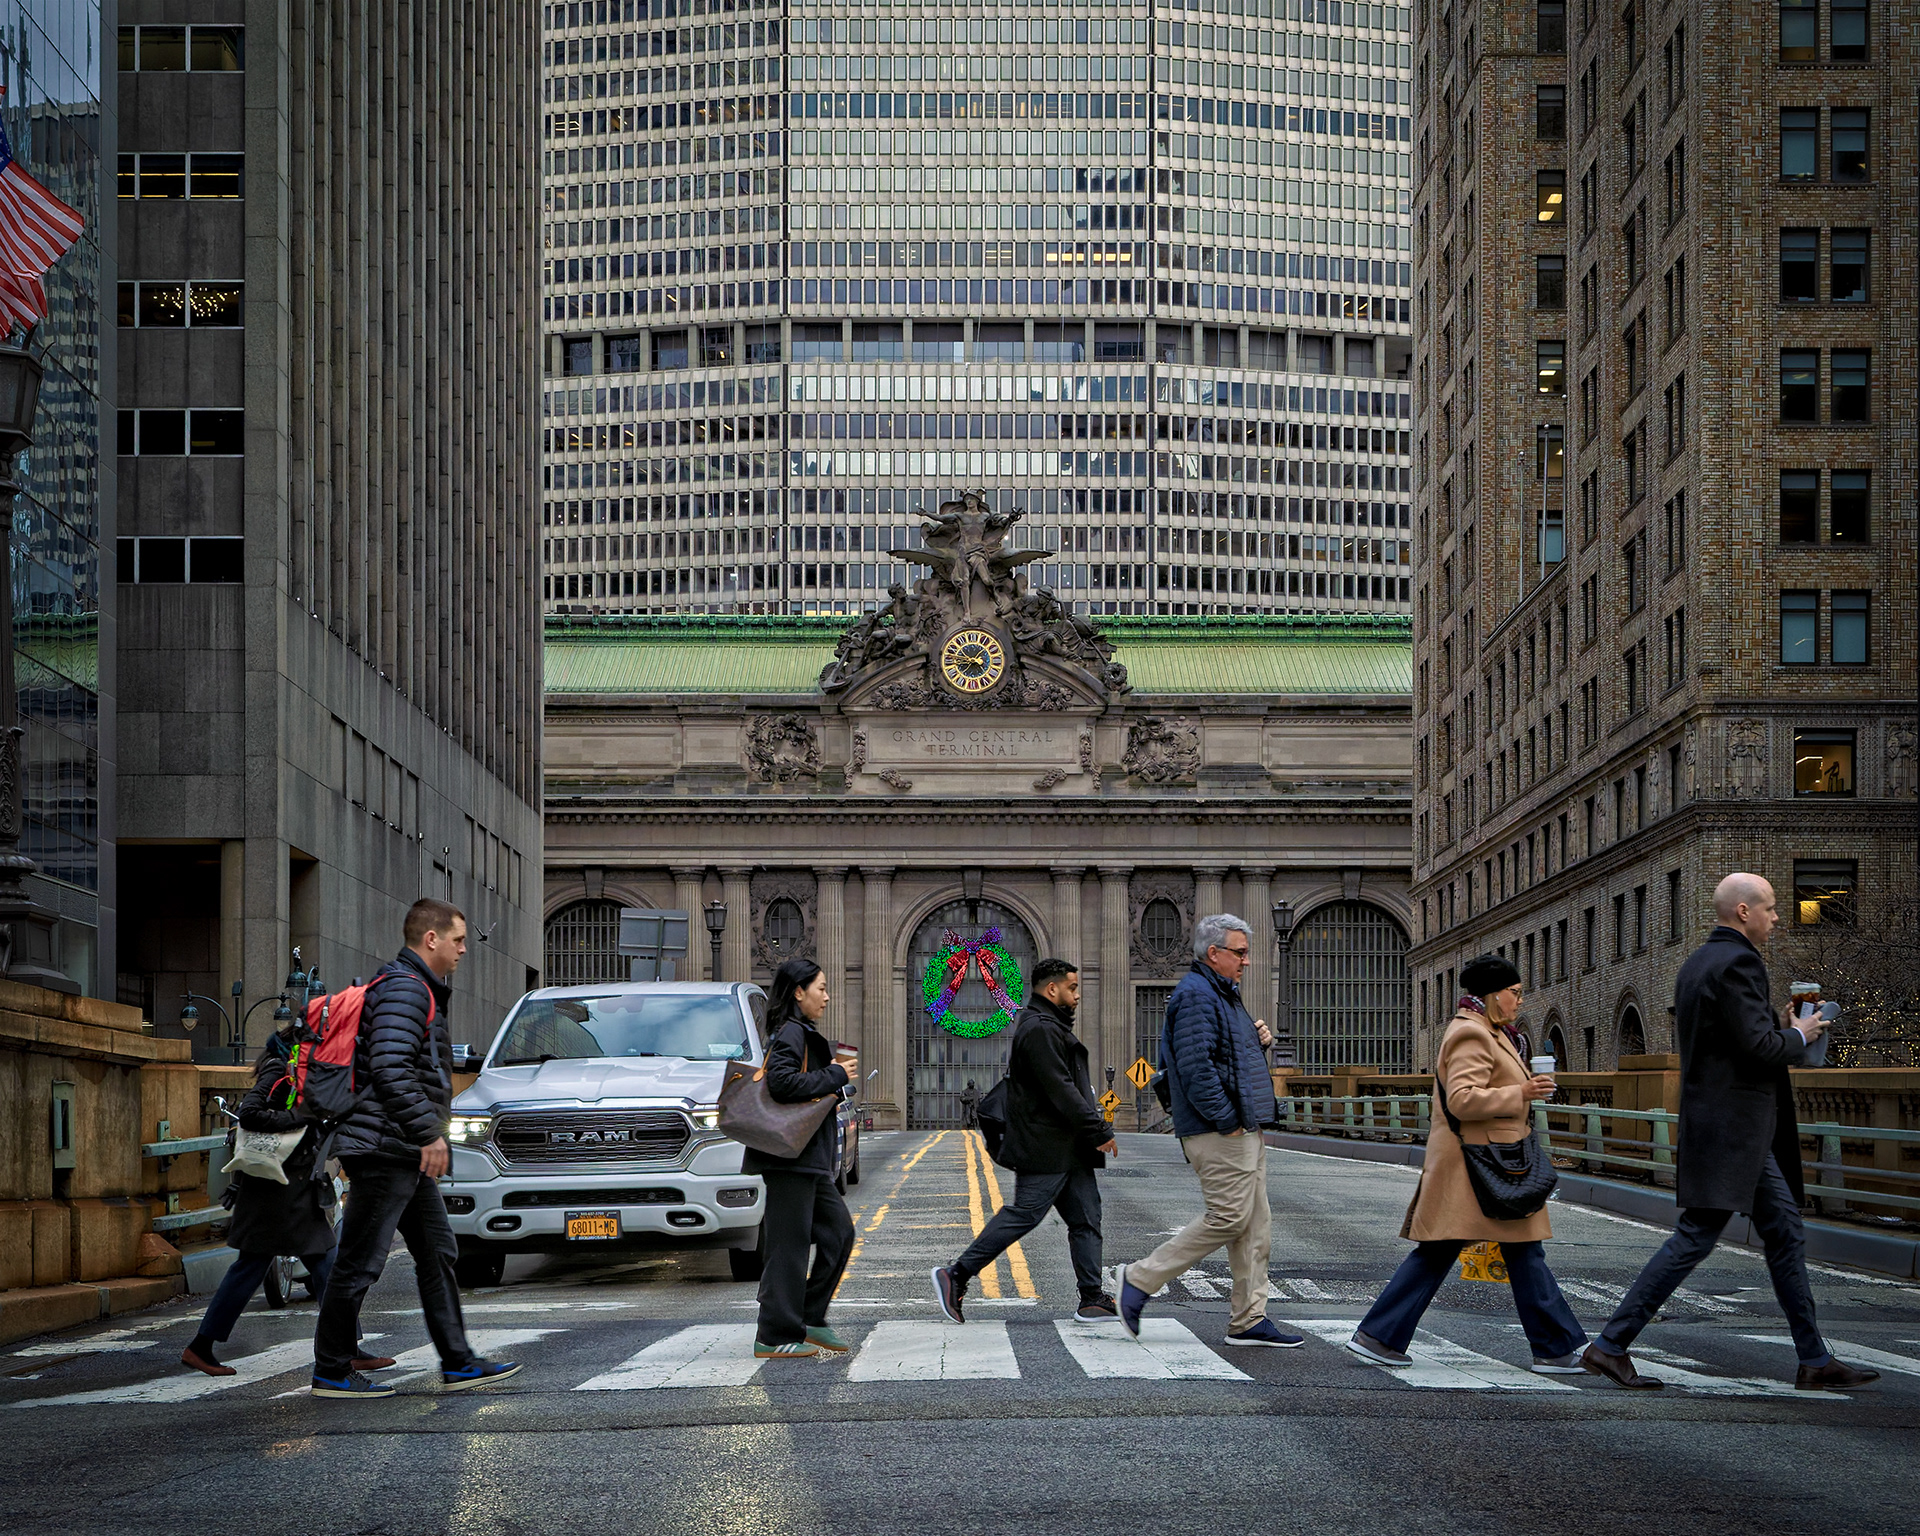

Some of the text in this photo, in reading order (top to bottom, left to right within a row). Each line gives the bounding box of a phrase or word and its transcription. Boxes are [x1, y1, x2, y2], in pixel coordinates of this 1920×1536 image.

[892, 730, 1053, 743] GRAND CENTRAL
[926, 744, 1018, 756] TERMINAL
[551, 1131, 630, 1142] RAM
